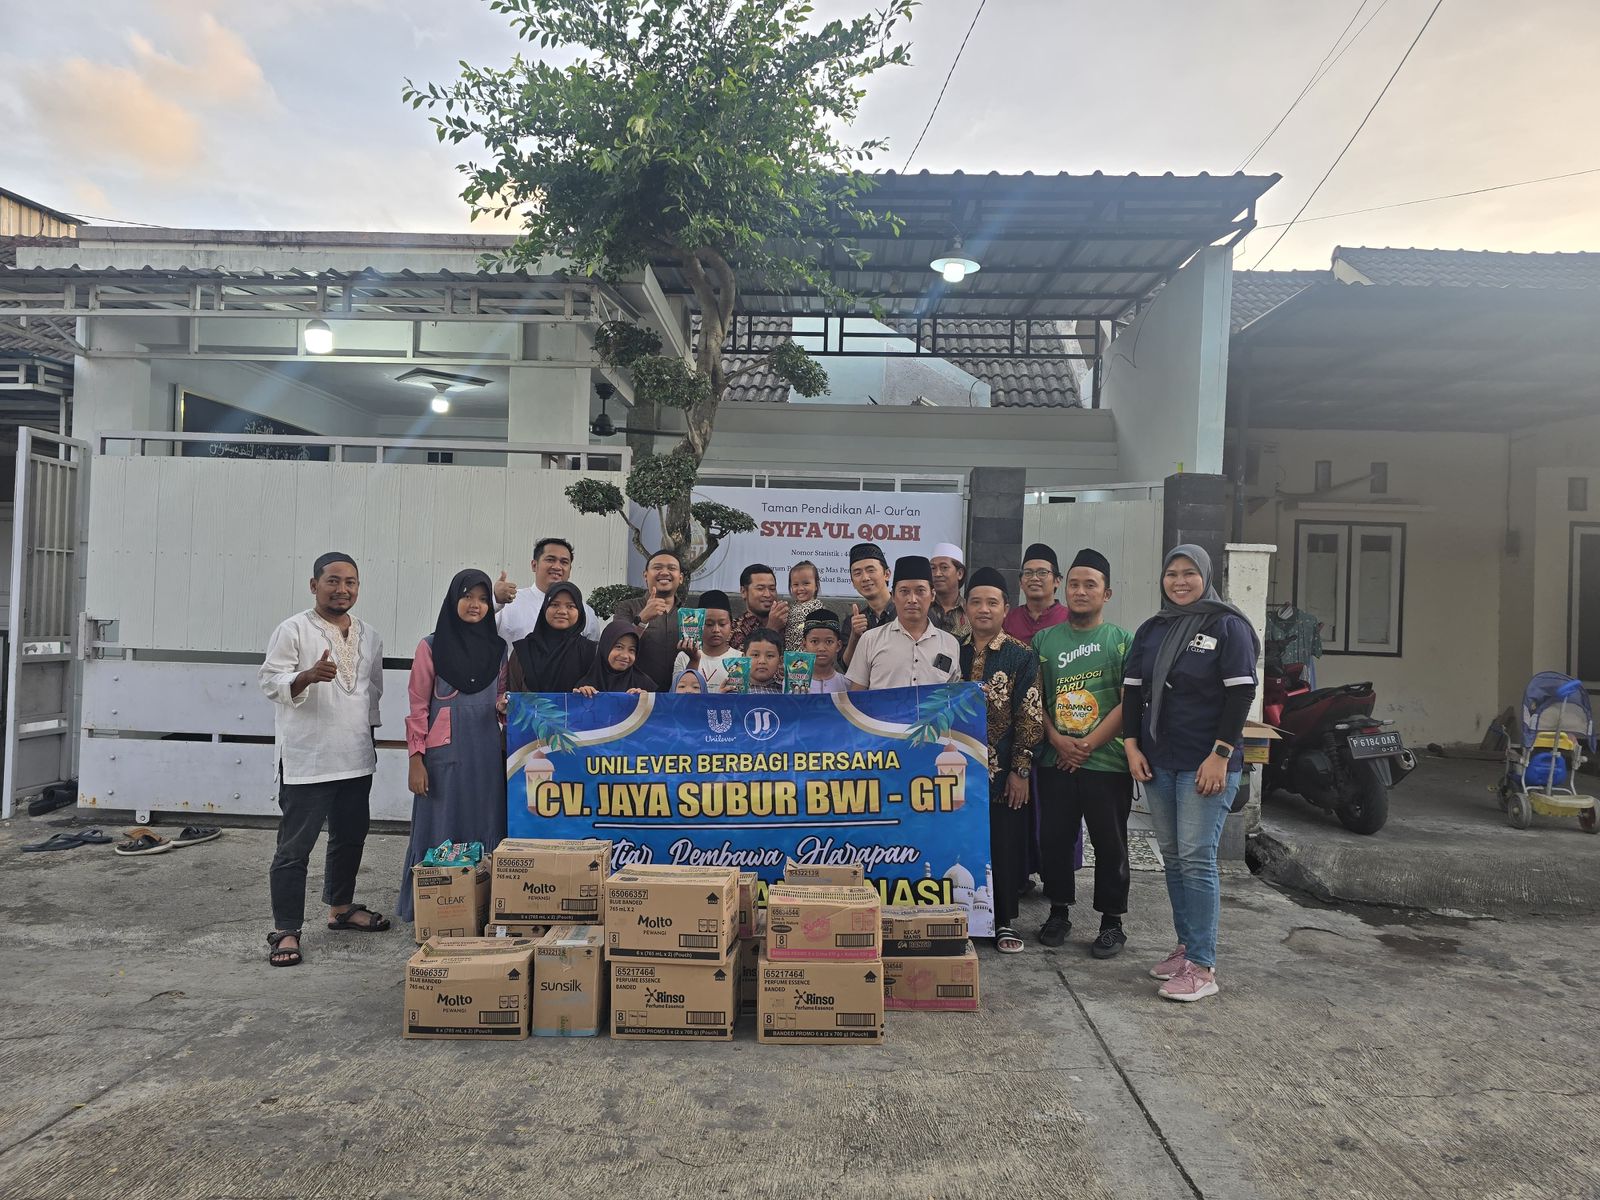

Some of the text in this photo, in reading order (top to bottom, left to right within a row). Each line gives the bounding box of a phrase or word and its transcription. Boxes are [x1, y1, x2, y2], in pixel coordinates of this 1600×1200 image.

[761, 502, 798, 513] Taman
[801, 502, 862, 515] Pendidikan
[865, 503, 881, 515] Al-
[760, 520, 921, 542] SYIFA'UL QOLBI
[791, 549, 813, 557] Nomor
[814, 549, 839, 557] Statistik
[1057, 642, 1101, 669] Sunlight
[1056, 670, 1103, 685] TEKNOLOGI
[1056, 680, 1085, 695] BARU
[1056, 703, 1093, 712] RHAMNO
[705, 734, 737, 743] Unilever
[585, 750, 901, 775] UNILEVER BERBAGI BERSAMA
[536, 781, 591, 817] CV.
[596, 781, 672, 817] JAYA
[678, 779, 799, 818] SUBUR
[806, 779, 881, 815] BWI
[910, 775, 958, 813] GT
[669, 838, 783, 867] Pembawa
[797, 836, 920, 872] Harapan
[498, 859, 533, 867] 65066357
[523, 882, 556, 894] Molto
[611, 889, 647, 898] 65066357
[864, 879, 951, 906] NASI
[436, 896, 465, 906] CLEAR
[637, 914, 673, 928] Molto
[411, 967, 448, 977] 65066357
[617, 968, 654, 976] 65217464
[765, 970, 803, 978] 65217464
[540, 979, 582, 992] sunsilk
[436, 993, 473, 1006] Molto
[657, 991, 685, 1004] Rinso
[806, 993, 834, 1005] Rinso
[617, 1012, 624, 1021] 8
[766, 1014, 772, 1023] 8
